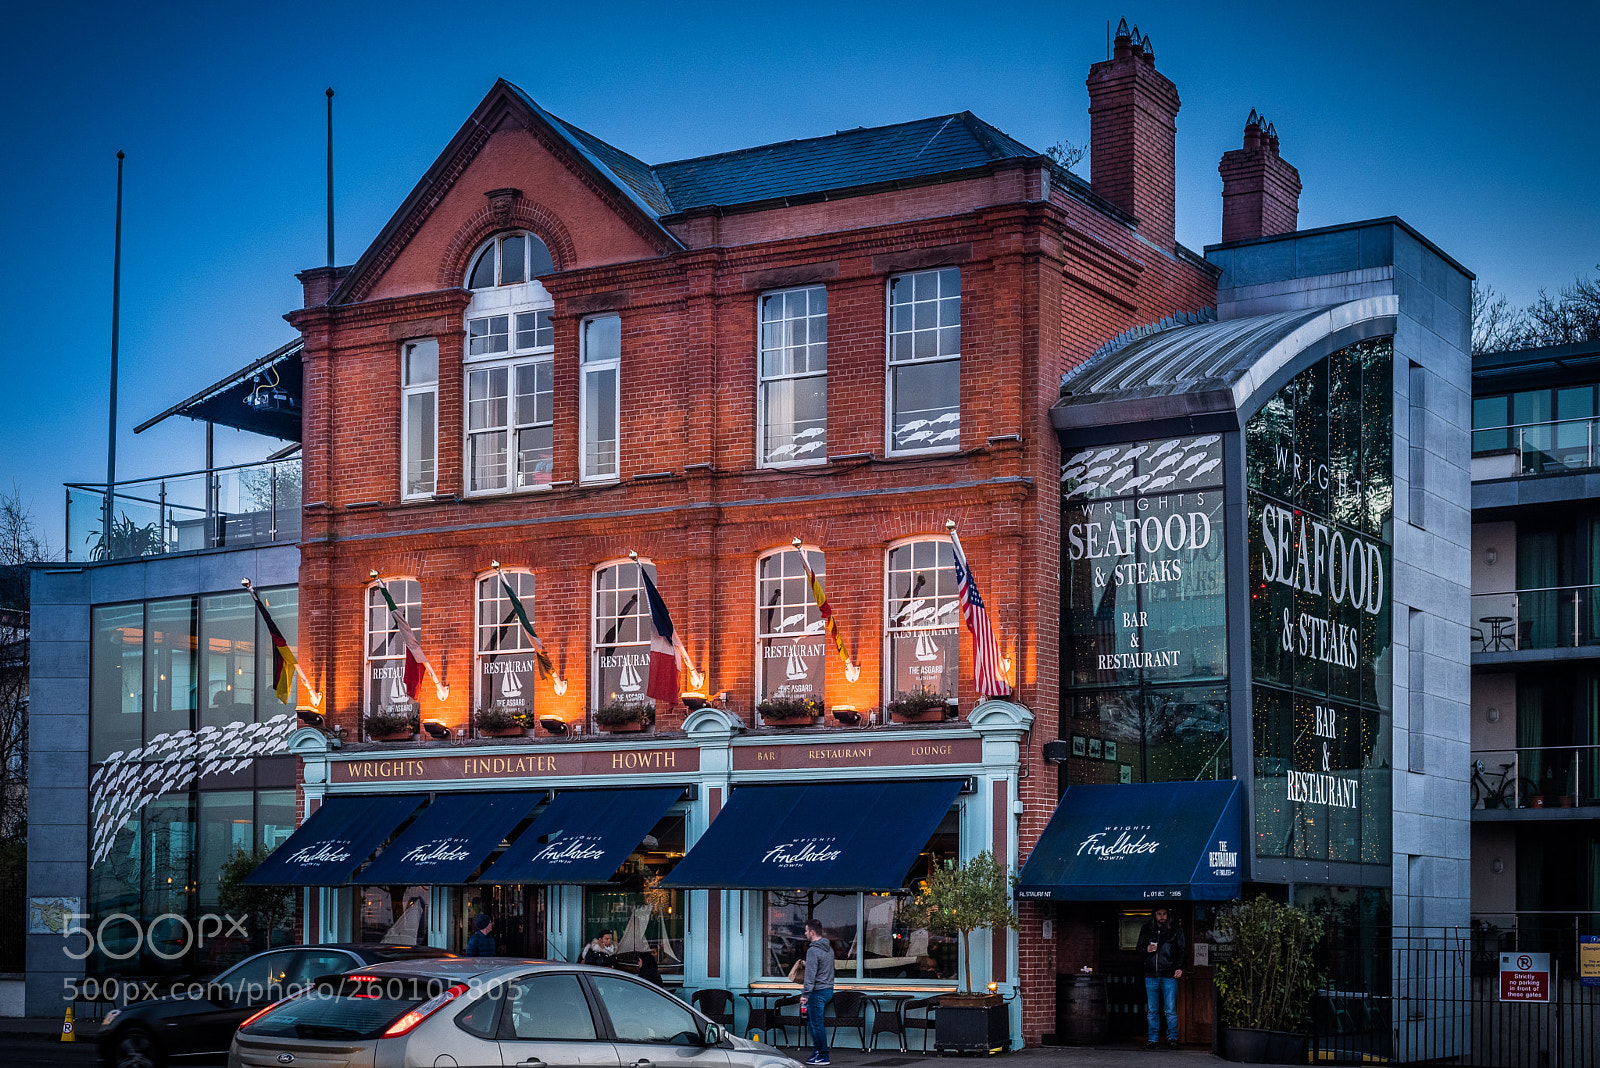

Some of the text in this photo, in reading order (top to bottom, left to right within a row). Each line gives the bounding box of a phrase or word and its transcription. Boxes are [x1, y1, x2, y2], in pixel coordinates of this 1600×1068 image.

[1081, 492, 1205, 516] WRIGHTS
[1068, 512, 1211, 560] SEAFOOD
[1262, 503, 1384, 616] SEAFOOD
[1094, 560, 1182, 588] & STEAKS
[1122, 612, 1149, 629] BAR
[1130, 633, 1139, 648] &
[1282, 607, 1358, 670] & STEAKS
[600, 653, 650, 668] RESTAURAN
[764, 643, 825, 659] RESTAURANT
[1098, 651, 1180, 670] RESTAURANT
[909, 665, 943, 675] THE ASGARD
[791, 684, 812, 693] ASGARD
[1316, 705, 1336, 739] BAR
[348, 751, 676, 777] WRIGHTS FINDLATER HOWTH
[757, 745, 952, 761] BAR RESTAURANT LOUNGE
[1322, 741, 1330, 772] &
[1287, 770, 1358, 809] RESTAURANT
[761, 841, 842, 864] Findlater
[1077, 831, 1160, 856] Findlater
[1219, 841, 1228, 852] THE
